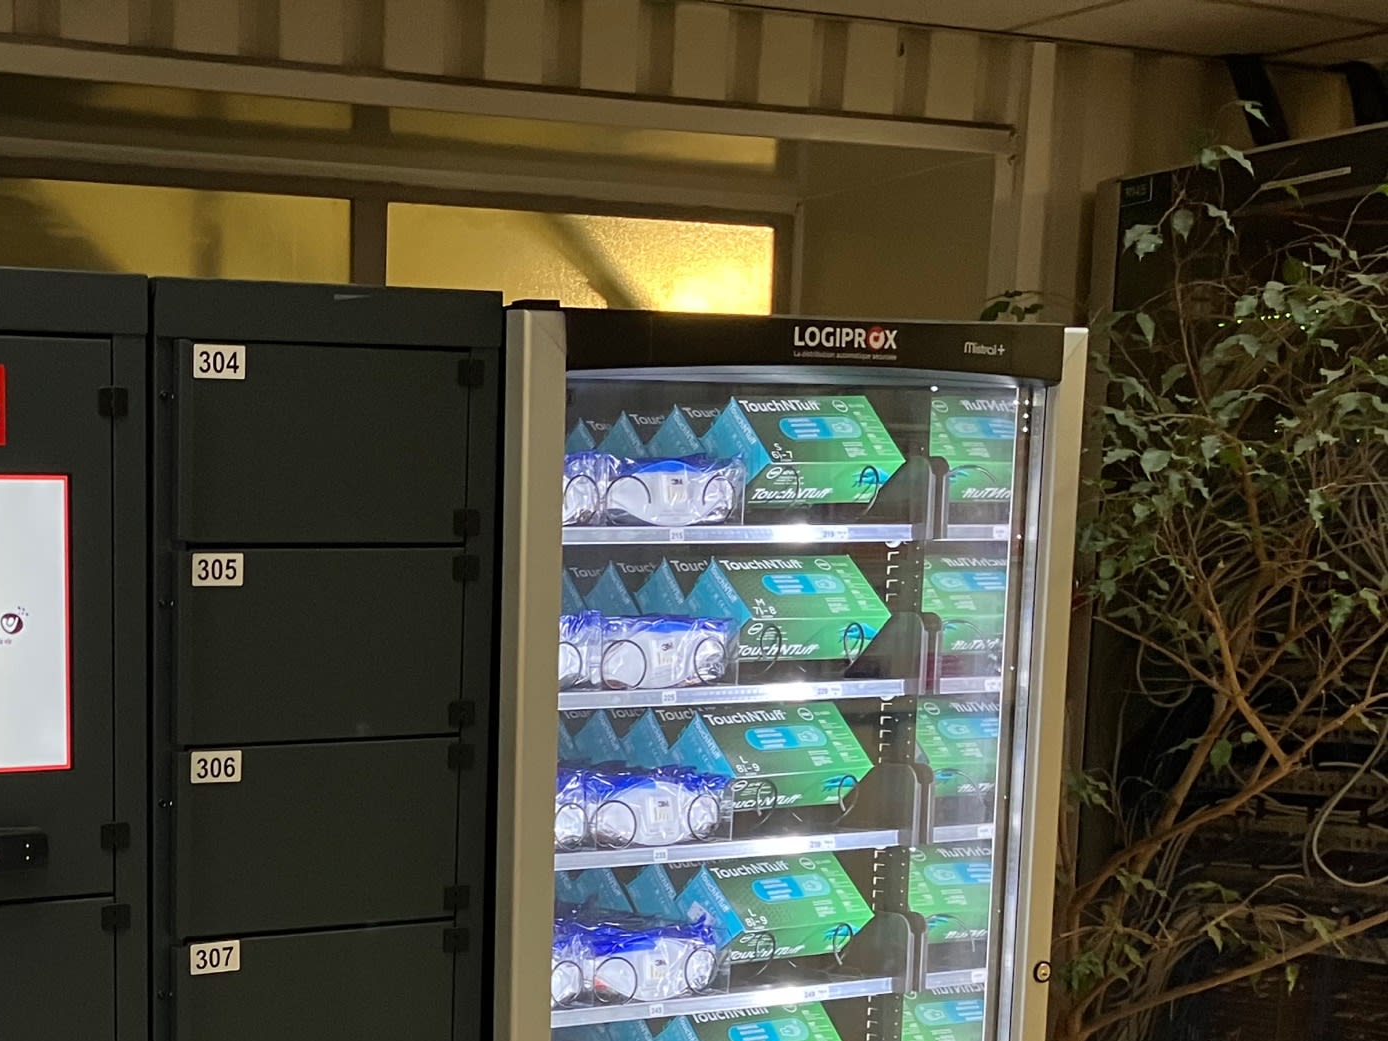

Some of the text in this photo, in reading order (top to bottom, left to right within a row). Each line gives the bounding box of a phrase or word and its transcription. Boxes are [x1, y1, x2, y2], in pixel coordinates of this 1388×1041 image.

[793, 326, 898, 351] LOGIPROX
[198, 351, 240, 375] 304
[738, 400, 821, 413] TouchNTuff
[774, 442, 782, 451] S
[197, 558, 238, 582] 305
[720, 559, 803, 572] TouchNTuff
[704, 710, 787, 727] TouchNTuff
[196, 756, 236, 780] 306
[710, 860, 789, 880] TouchNTuff
[195, 946, 234, 970] 307
